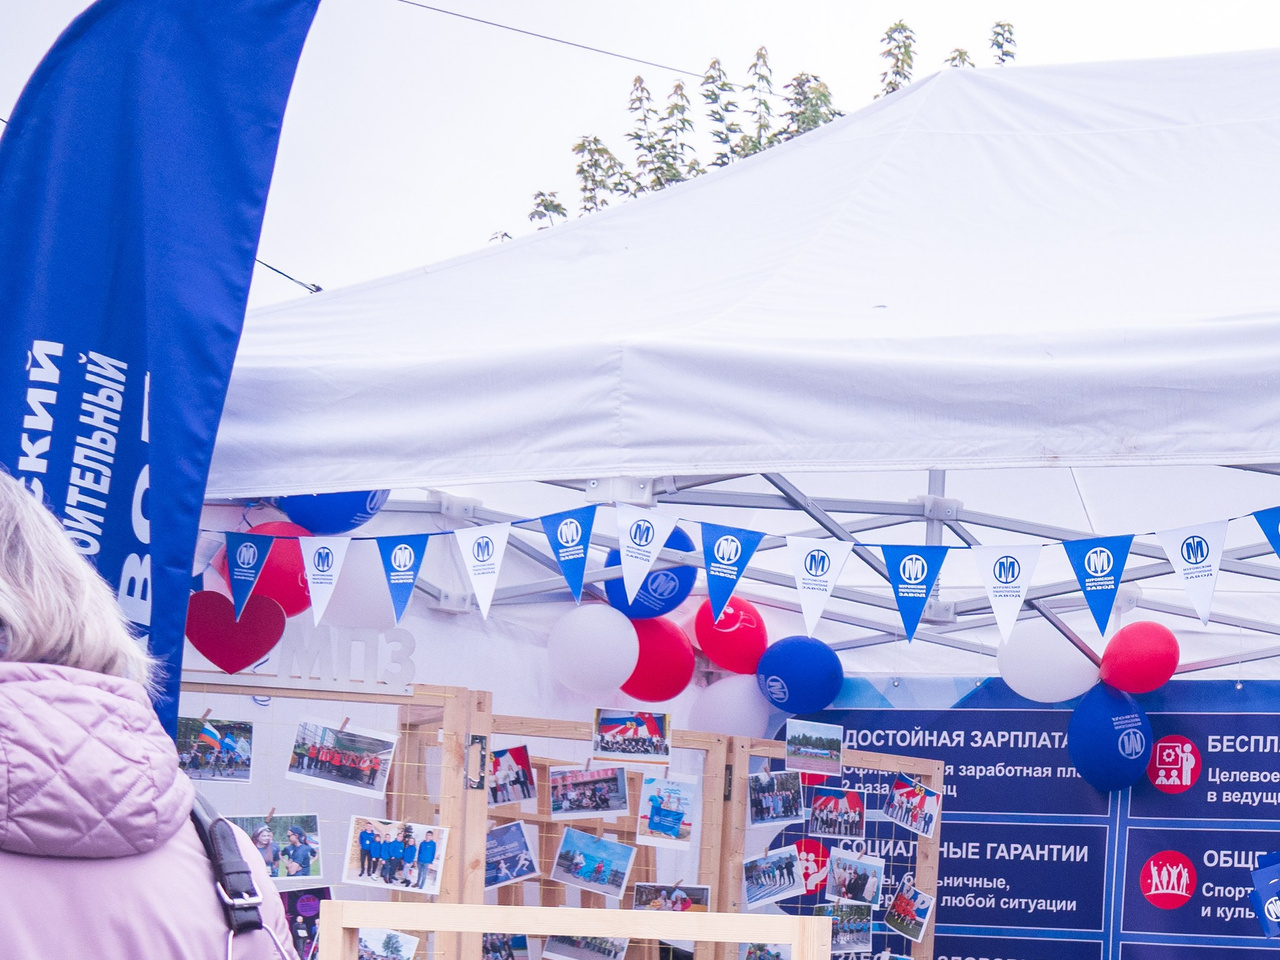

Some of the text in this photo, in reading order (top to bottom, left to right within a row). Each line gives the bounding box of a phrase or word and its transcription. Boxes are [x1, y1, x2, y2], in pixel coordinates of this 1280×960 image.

[843, 726, 965, 748] ДОСТОЙНАЯ
[959, 762, 1052, 780] заработная
[1208, 767, 1280, 784] Целевое
[855, 783, 890, 796] раза
[1207, 791, 1218, 802] в
[840, 839, 1089, 863] СОЦИАЛНЫЕ ГАРАНТИИ
[941, 893, 995, 908] любой
[1000, 896, 1077, 912] ситуации
[1201, 906, 1259, 922] и куль
